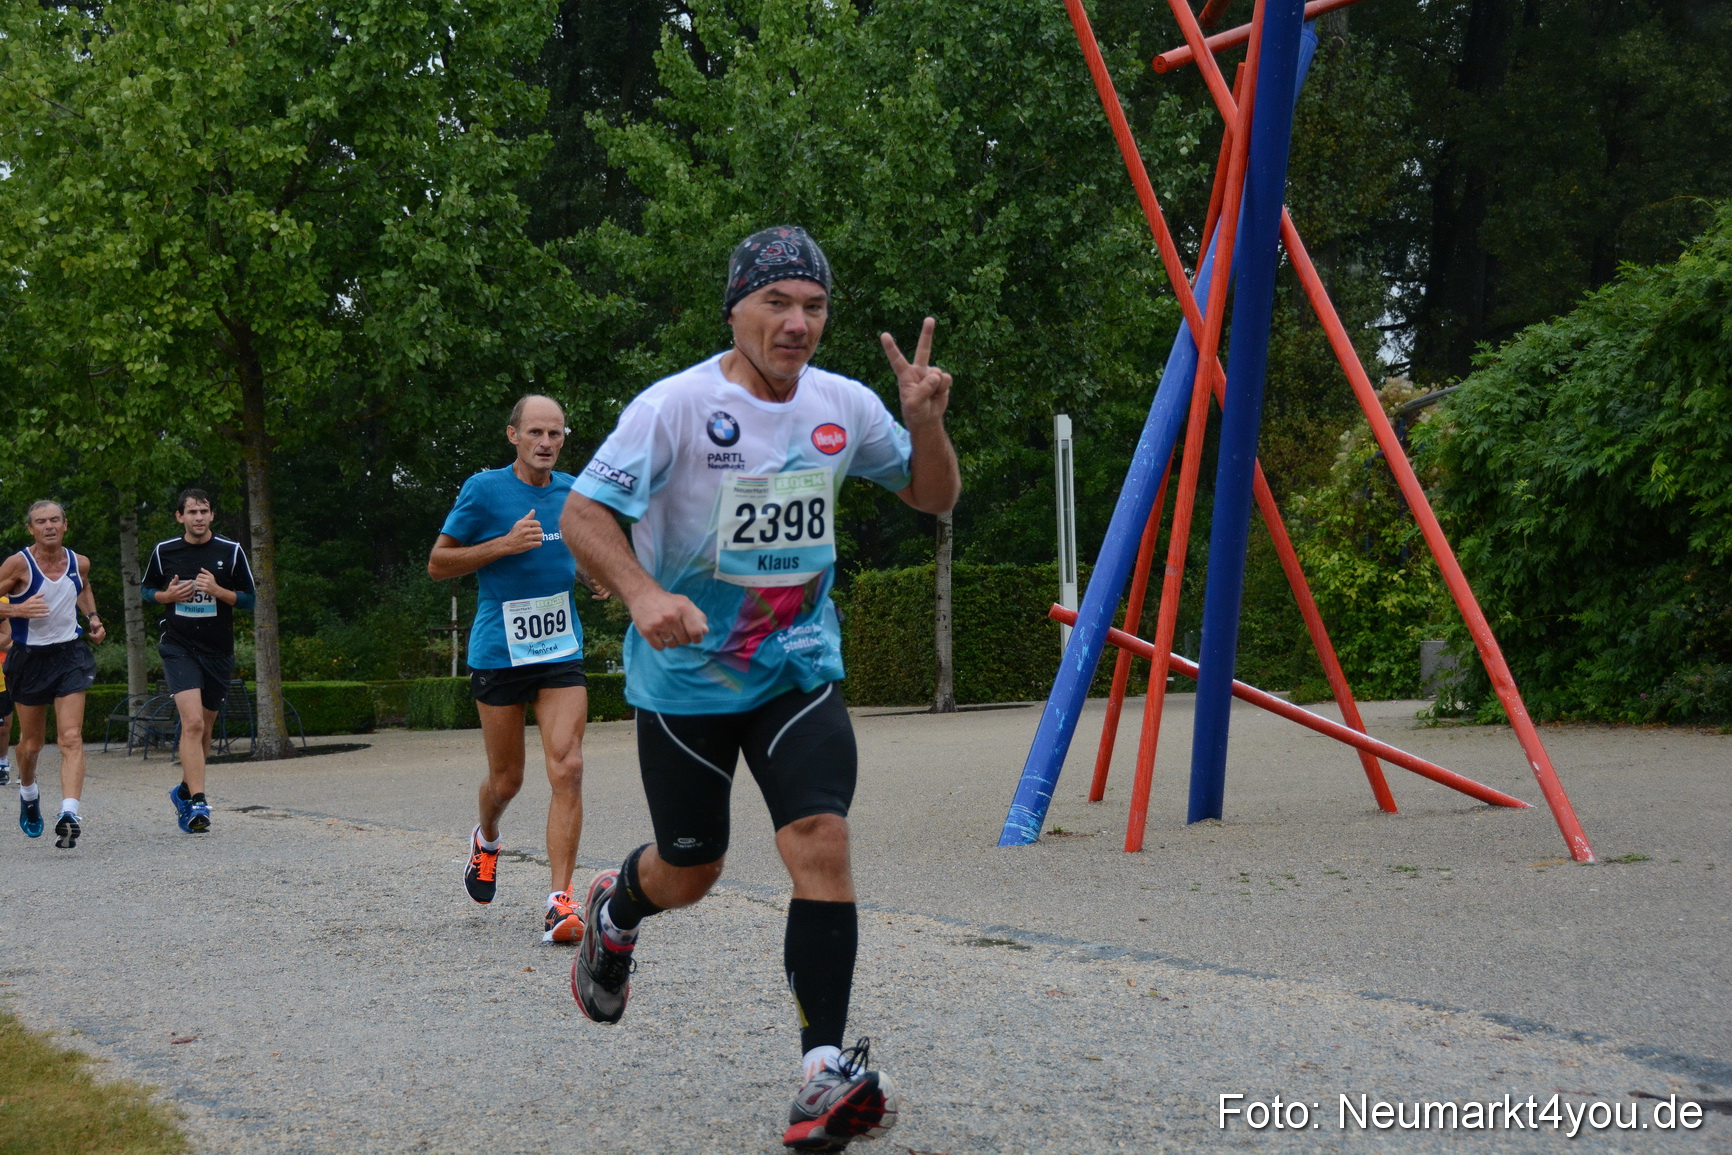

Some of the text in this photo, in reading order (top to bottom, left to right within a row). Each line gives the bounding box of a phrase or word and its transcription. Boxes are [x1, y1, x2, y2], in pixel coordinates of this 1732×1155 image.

[708, 453, 745, 463] PARTL
[774, 472, 826, 491] BOCK
[733, 497, 825, 543] 2398
[758, 555, 799, 571] Klaus
[185, 605, 205, 613] Philipp
[513, 609, 566, 641] 3069
[527, 643, 559, 656] Manfred
